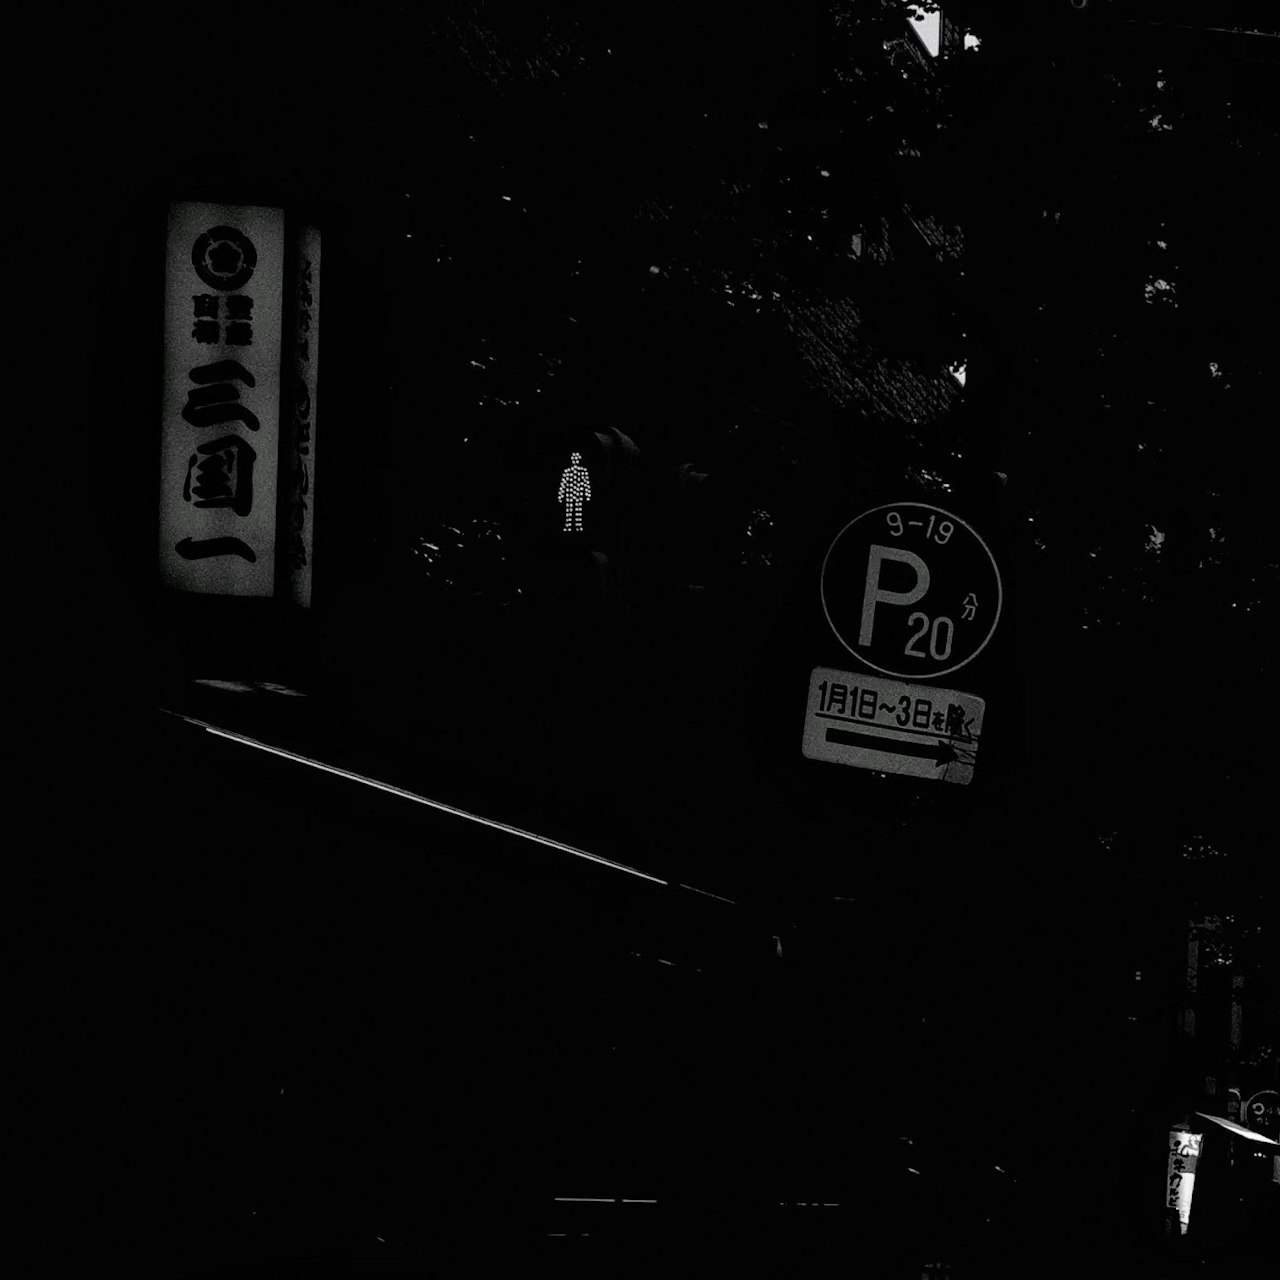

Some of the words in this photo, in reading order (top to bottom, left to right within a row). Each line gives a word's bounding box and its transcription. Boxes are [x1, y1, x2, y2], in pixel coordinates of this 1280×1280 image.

[887, 512, 954, 544] 9-19
[858, 544, 930, 646] P
[904, 612, 954, 661] 20
[961, 593, 978, 620] 分
